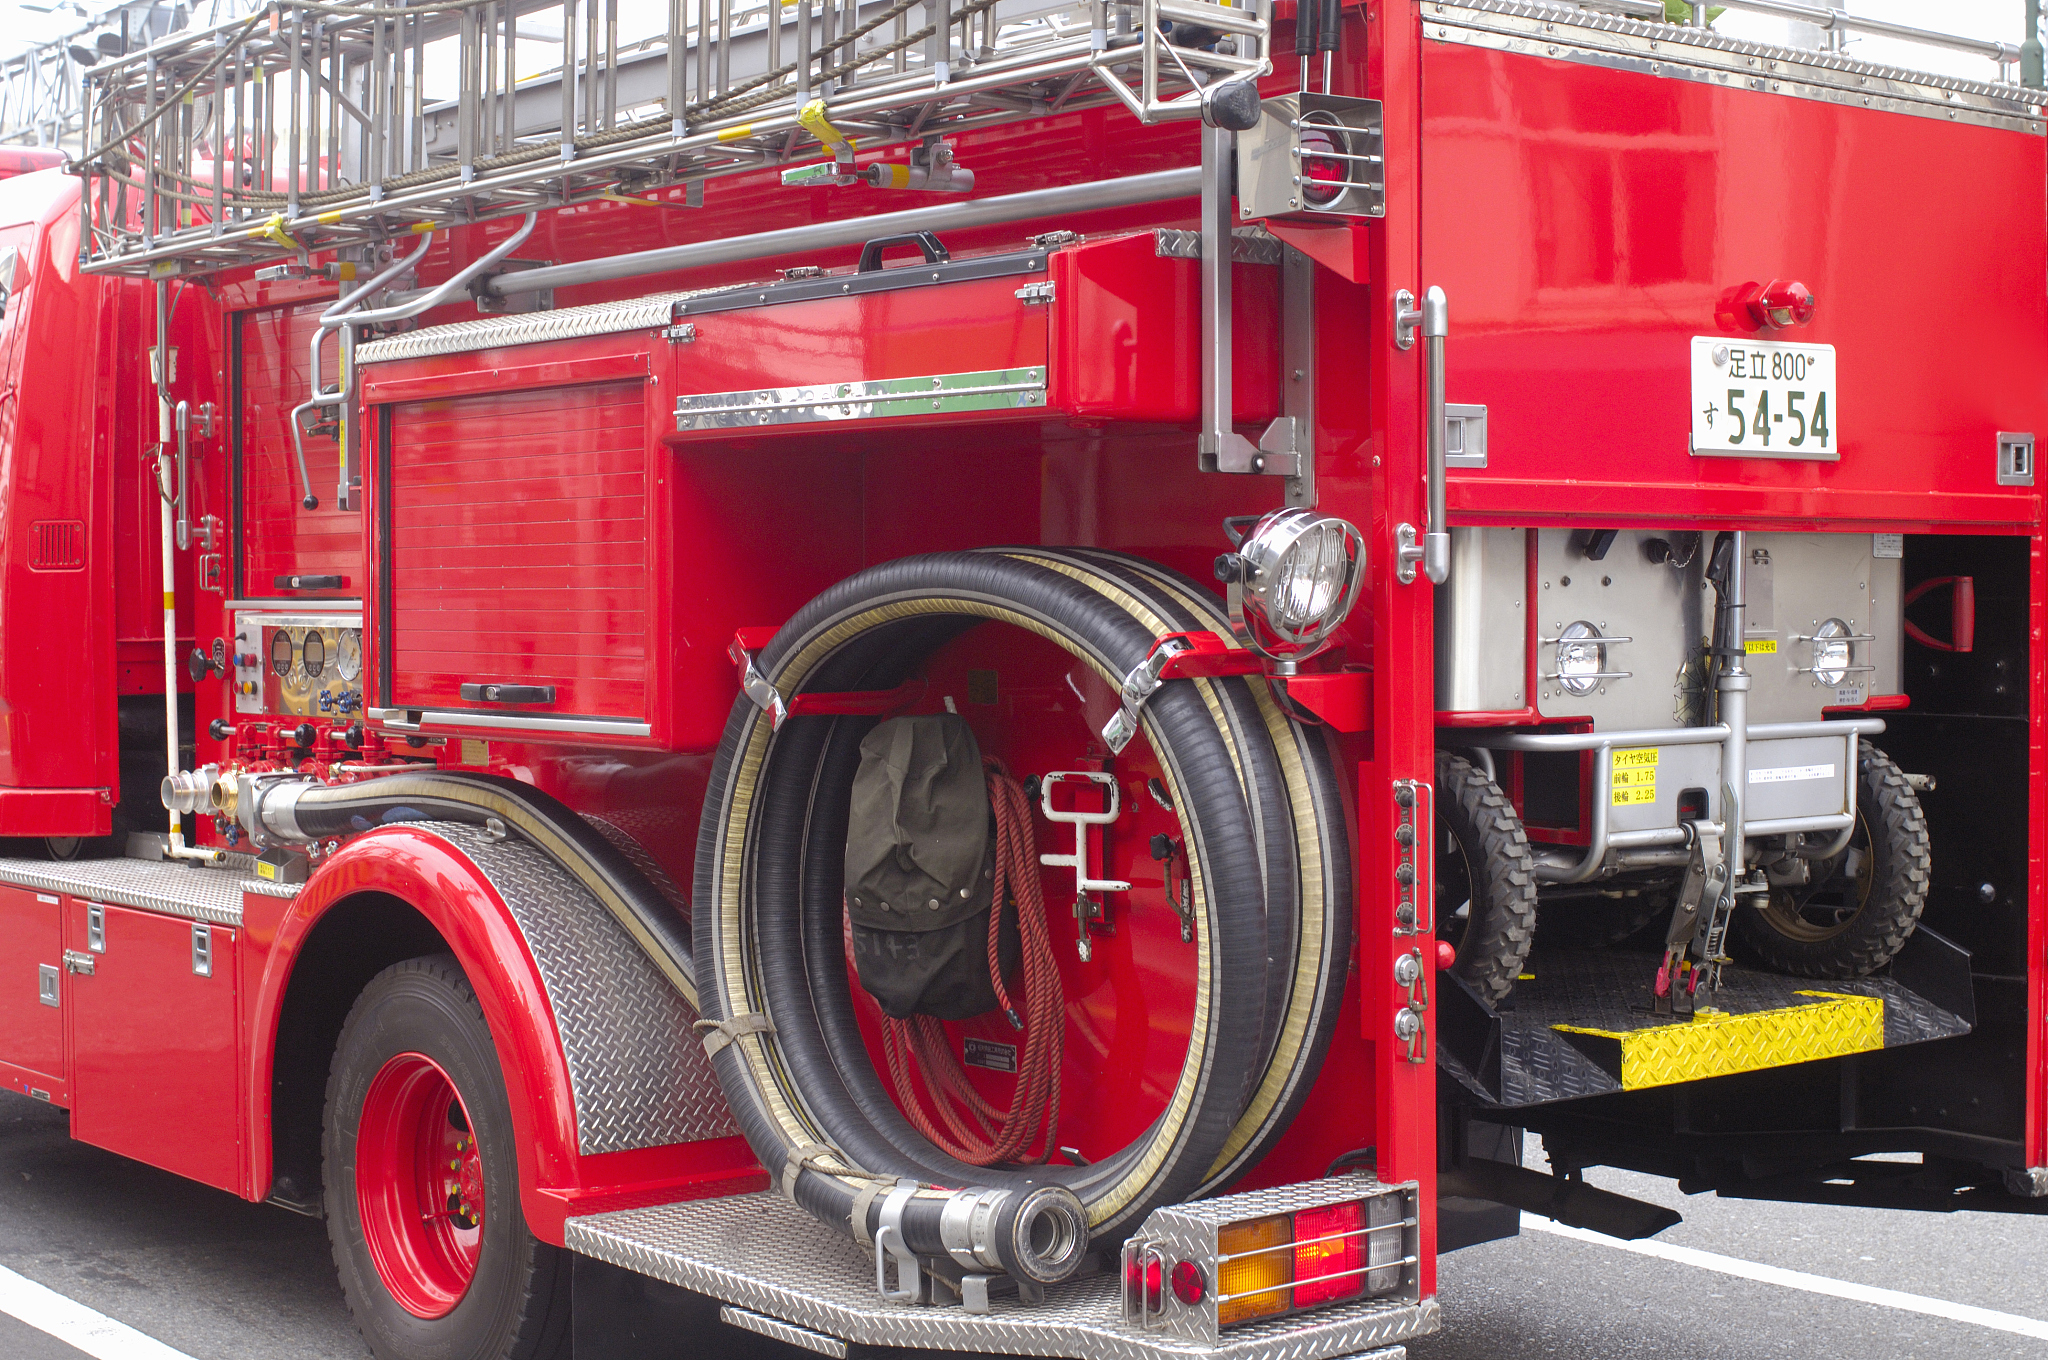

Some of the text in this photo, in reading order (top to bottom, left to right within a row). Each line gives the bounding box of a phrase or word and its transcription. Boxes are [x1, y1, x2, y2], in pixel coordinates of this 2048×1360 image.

[1729, 350, 1805, 381] 足立 800
[1703, 389, 1829, 448] す 54-54
[1614, 752, 1657, 766] タイヤ空気圧
[1636, 771, 1654, 781] 1.75
[1636, 790, 1654, 800] 2.25
